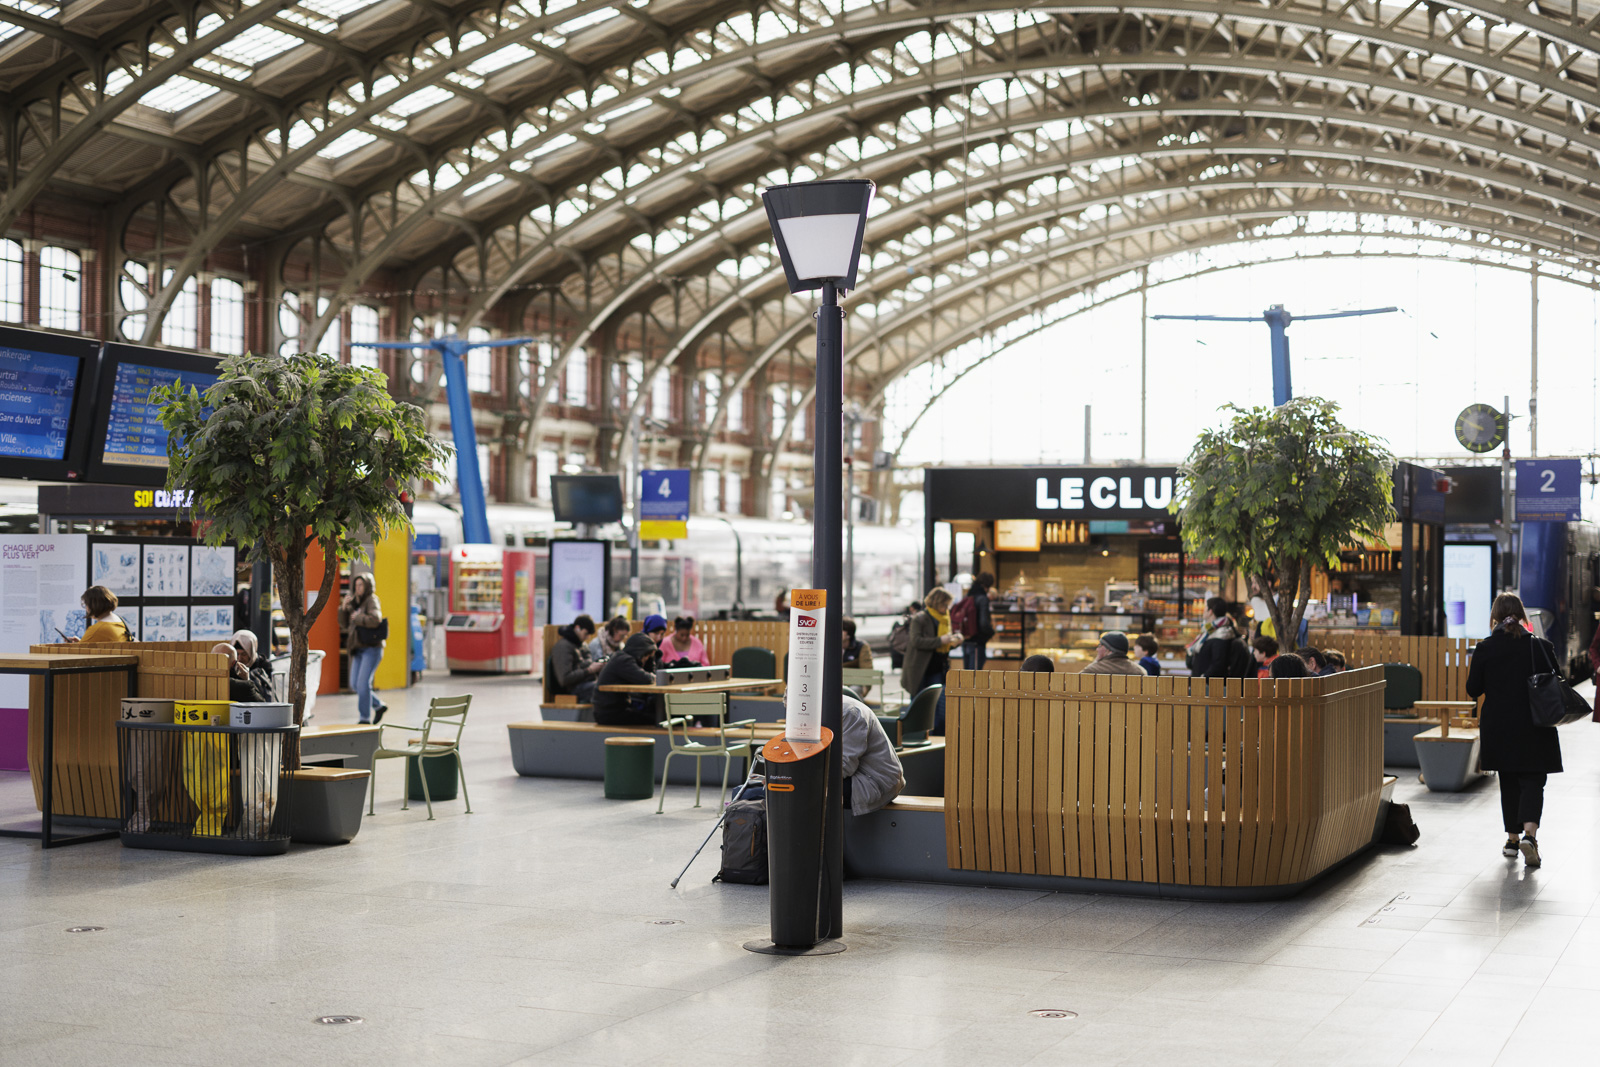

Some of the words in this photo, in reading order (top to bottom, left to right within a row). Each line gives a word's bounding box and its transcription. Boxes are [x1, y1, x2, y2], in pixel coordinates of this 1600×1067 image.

[15, 415, 24, 423] du
[25, 416, 42, 425] Nord
[1, 433, 17, 444] Ville
[1541, 470, 1555, 492] 2
[658, 477, 672, 499] 4
[1036, 477, 1085, 509] LE
[134, 490, 153, 507] SO!
[2, 544, 33, 552] CHAQUE
[35, 544, 55, 552] JOUR
[798, 619, 816, 627] SNCF
[803, 664, 808, 674] 1
[801, 683, 808, 693] 3
[801, 702, 807, 712] 5
